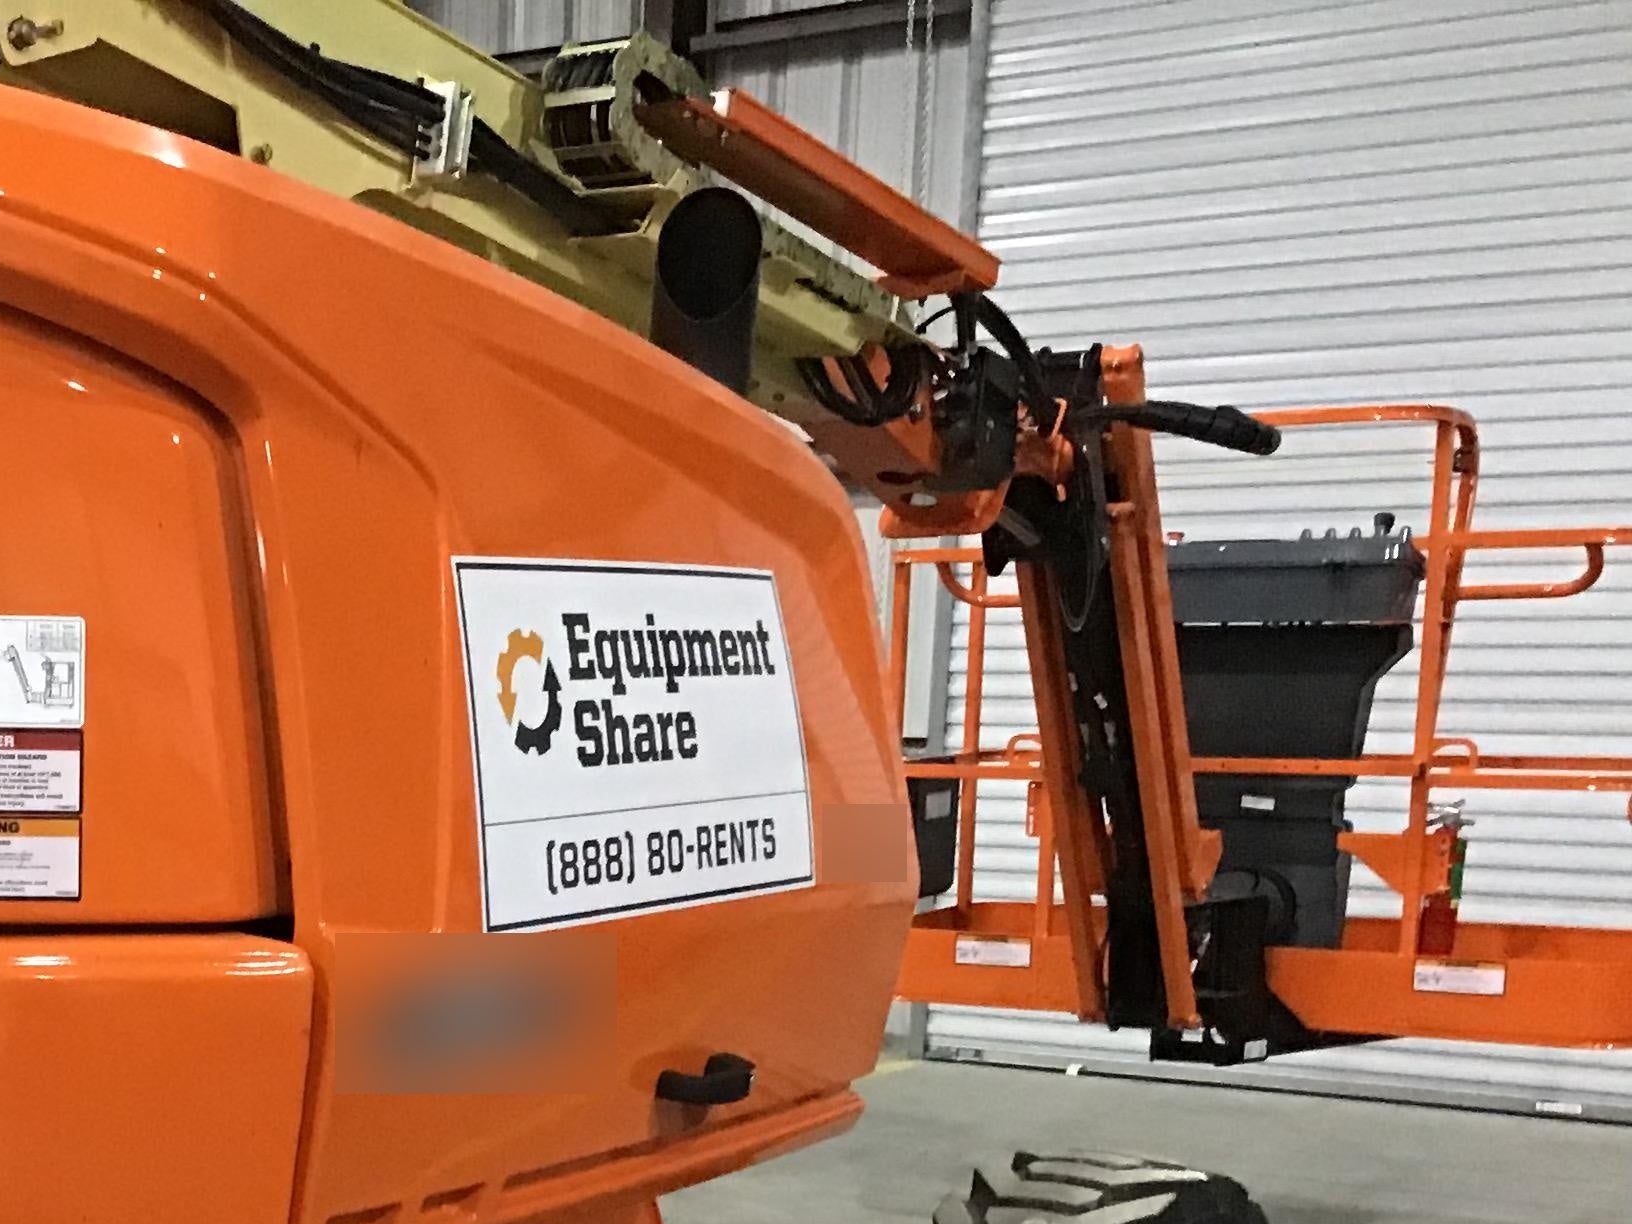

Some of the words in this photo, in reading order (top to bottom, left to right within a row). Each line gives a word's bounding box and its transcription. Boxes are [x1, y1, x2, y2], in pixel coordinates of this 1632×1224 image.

[561, 612, 776, 695] Equipment
[573, 699, 699, 768] Share
[546, 831, 635, 895] (888)
[647, 818, 777, 877] 80-RENTS
